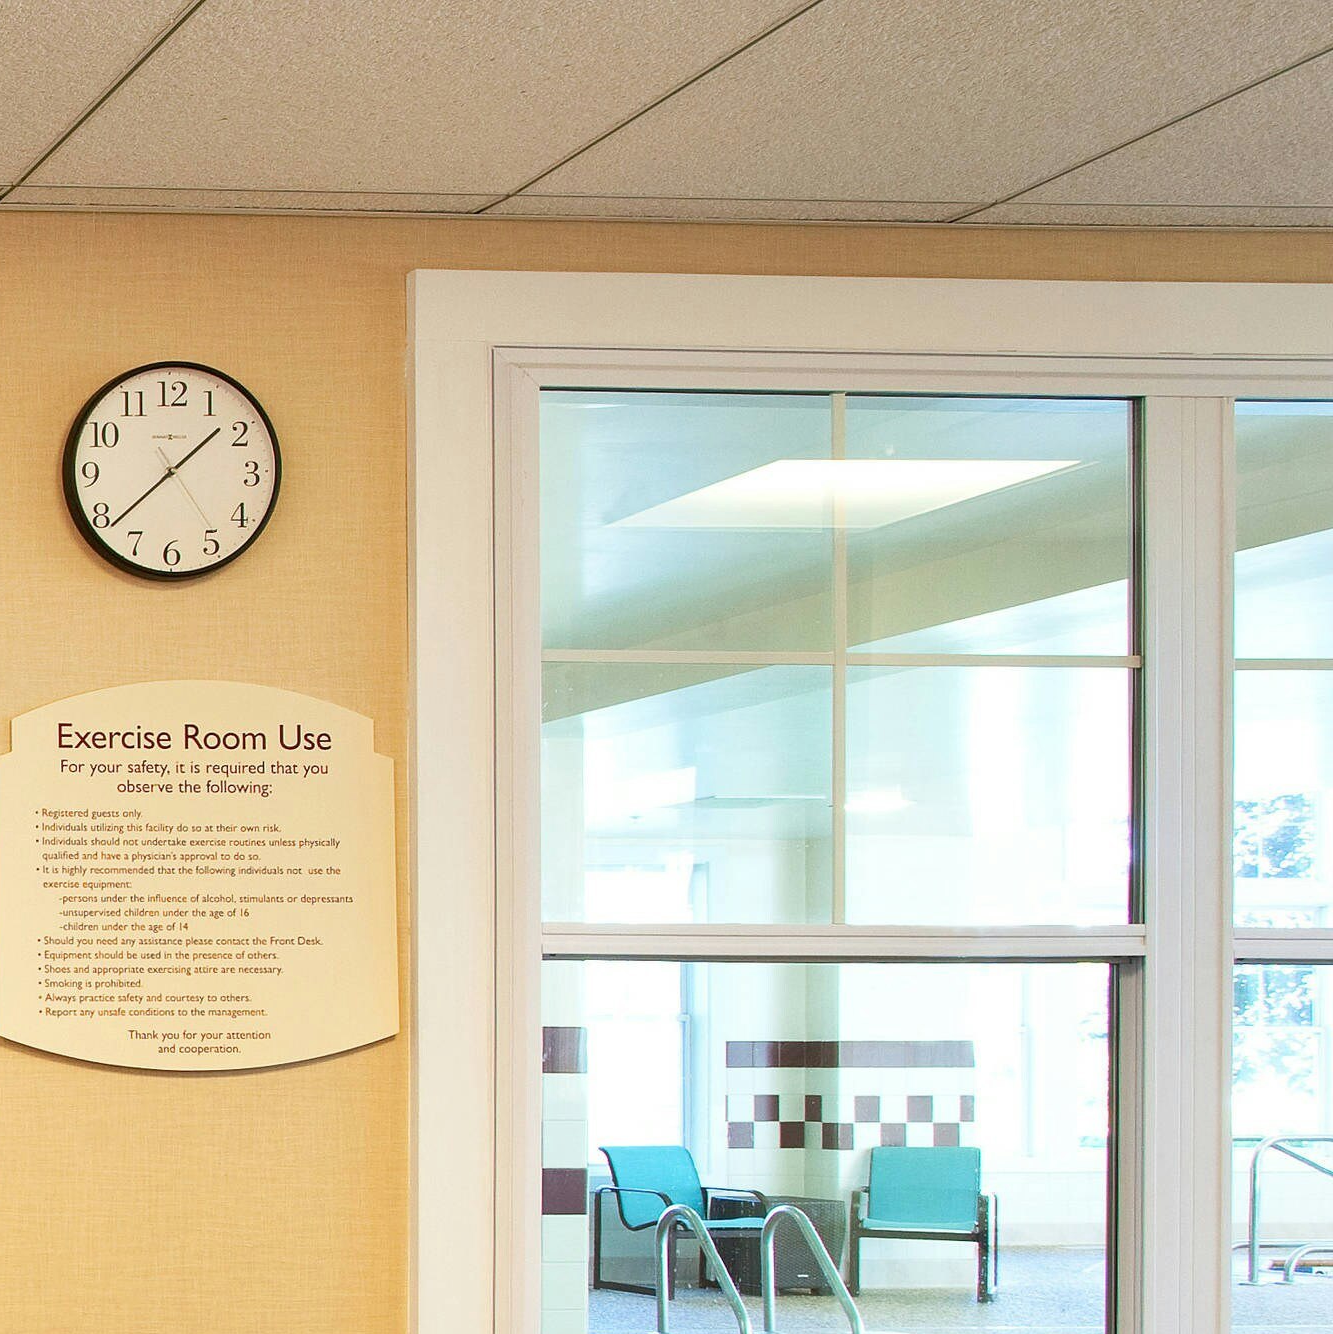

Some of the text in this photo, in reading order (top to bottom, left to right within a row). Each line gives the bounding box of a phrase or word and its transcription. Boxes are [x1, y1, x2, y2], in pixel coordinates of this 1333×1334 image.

[157, 381, 188, 407] 12
[120, 391, 147, 417] 11
[203, 391, 216, 416] 1
[89, 422, 119, 448] 10
[231, 422, 249, 447] 2
[81, 461, 99, 488] 9
[243, 461, 260, 487] 3
[93, 503, 110, 529] 8
[230, 503, 249, 528] 4
[127, 531, 143, 556] 7
[203, 529, 220, 555] 5
[163, 540, 181, 566] 6
[58, 723, 331, 750] Exercise Room Use
[61, 759, 328, 777] For your safety, it is required that you
[117, 779, 272, 797] observe the following:
[42, 808, 89, 820] Registered
[91, 811, 121, 820] guests
[42, 822, 88, 832] Individuals
[91, 823, 124, 834] utilizing
[127, 823, 143, 832] this
[146, 823, 174, 834] facility
[176, 823, 188, 832] do
[216, 824, 239, 832] their
[42, 837, 89, 846] Individuals
[91, 837, 120, 846] should
[141, 837, 187, 846] undertake
[269, 838, 296, 847] unless
[299, 838, 340, 849] physically
[42, 851, 79, 862] qualified
[82, 851, 98, 860] and
[101, 851, 121, 860] have
[132, 851, 177, 862] physician's
[179, 851, 217, 863] approval
[233, 852, 245, 860] do
[43, 865, 49, 874] It
[52, 866, 59, 874] is
[62, 865, 87, 877] highly
[90, 866, 155, 874] recommended
[157, 866, 176, 874] that
[178, 866, 193, 874] the
[195, 865, 236, 877] following
[238, 866, 284, 875] individuals
[325, 866, 341, 875] the
[43, 880, 79, 888] exercise
[101, 894, 127, 903] under
[130, 894, 145, 902] the
[148, 894, 187, 903] influence
[190, 894, 200, 903] of
[239, 894, 284, 903] stimulants
[301, 894, 354, 905] depressants
[124, 908, 159, 917] children
[163, 908, 189, 917] under
[192, 908, 207, 917] the
[209, 910, 224, 919] age
[227, 908, 237, 917] of
[240, 908, 249, 917] 16
[102, 922, 129, 931] under
[131, 922, 146, 931] the
[148, 924, 163, 933] age
[166, 922, 178, 931] of
[179, 922, 188, 931] 14
[44, 936, 74, 945] Should
[76, 939, 93, 947] you
[96, 937, 118, 945] need
[121, 938, 136, 947] any
[137, 937, 183, 945] assistance
[185, 936, 213, 947] please
[216, 938, 250, 946] contact
[252, 937, 267, 945] the
[270, 936, 295, 945] Front
[44, 950, 92, 961] Equipment
[94, 950, 124, 959] should
[126, 951, 137, 959] be
[141, 950, 161, 959] used
[164, 951, 172, 959] in
[175, 951, 189, 959] the
[192, 953, 233, 962] presence
[235, 950, 245, 959] of
[44, 964, 71, 973] Shoes
[73, 965, 89, 973] and
[92, 967, 145, 976] appropriate
[147, 965, 191, 976] exercising
[194, 965, 219, 974] attire
[45, 978, 83, 990] Smoking
[85, 980, 92, 988] is
[45, 993, 76, 1004] Always
[78, 994, 115, 1004] practice
[118, 993, 144, 1004] safety
[146, 993, 162, 1002] and
[165, 995, 205, 1004] courtesy
[45, 1007, 77, 1018] Report
[80, 1010, 95, 1018] any
[98, 1007, 126, 1016] unsafe
[129, 1008, 175, 1016] conditions
[191, 1007, 205, 1016] the
[129, 1030, 271, 1042] Thank you for your attention
[158, 1044, 175, 1053] and
